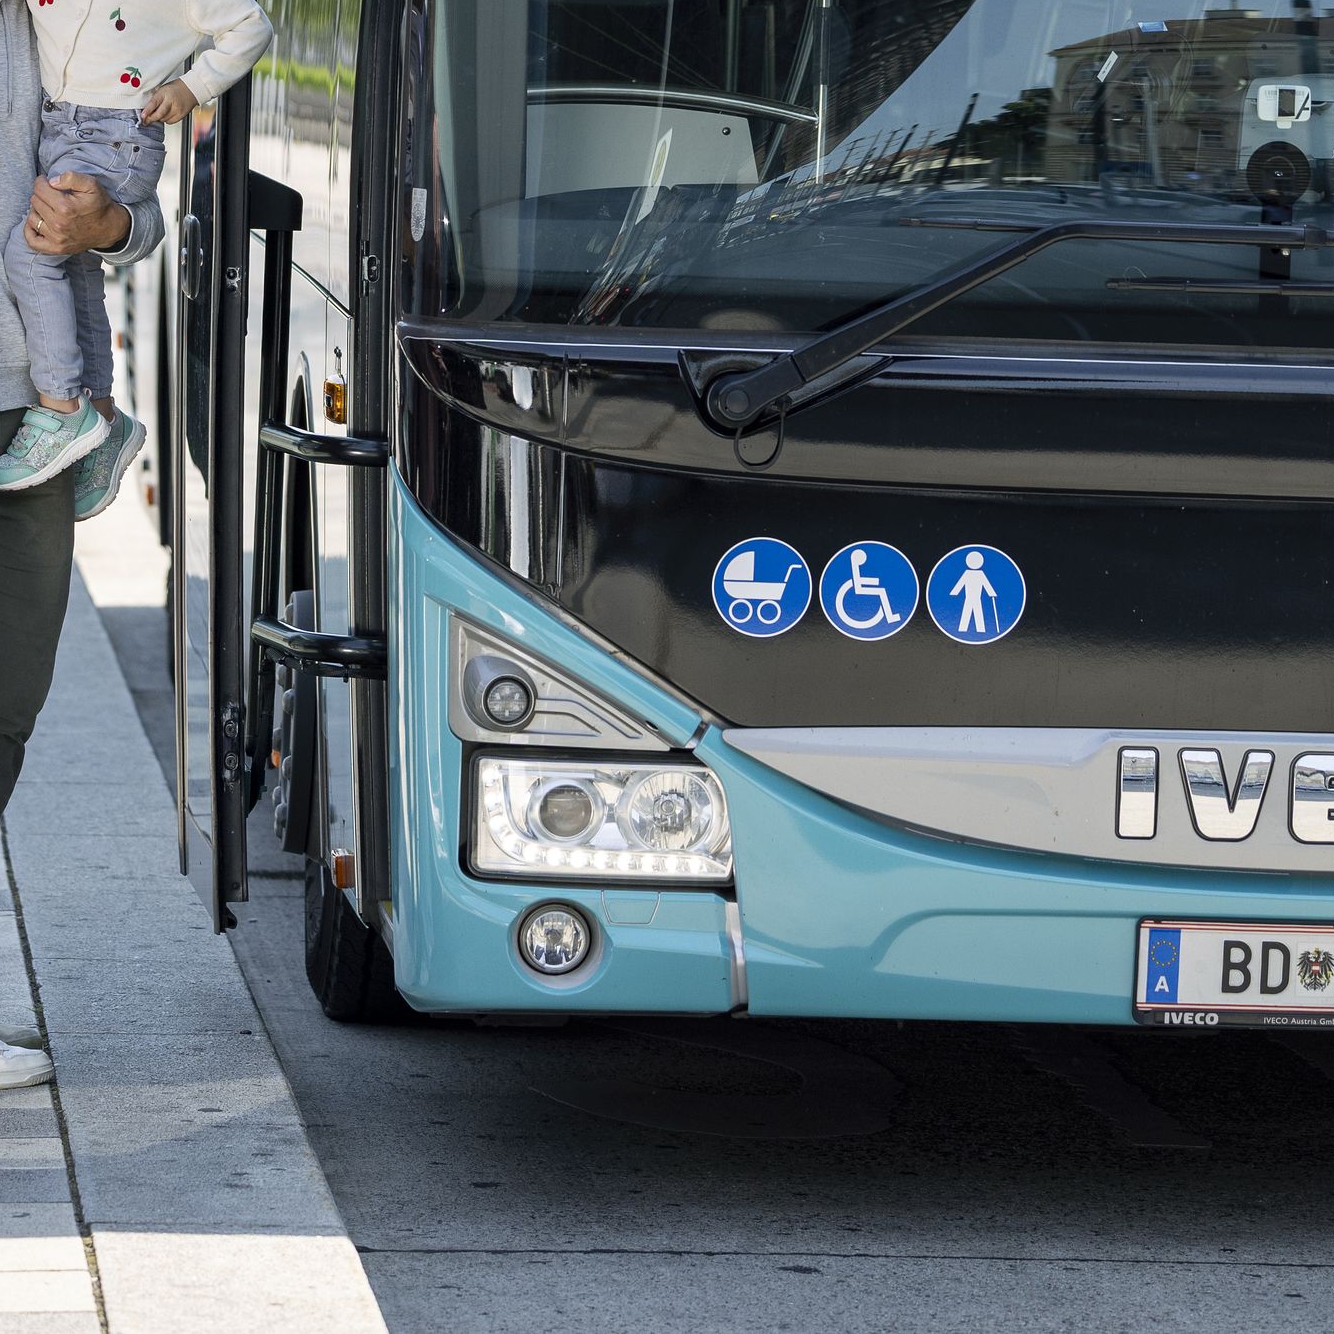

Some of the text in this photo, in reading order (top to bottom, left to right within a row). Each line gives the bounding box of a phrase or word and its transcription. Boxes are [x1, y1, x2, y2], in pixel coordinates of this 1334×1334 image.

[1221, 939, 1291, 995] BD
[1154, 975, 1170, 993] A
[1163, 1011, 1219, 1025] IVECO
[1263, 1016, 1289, 1025] IVECO
[1291, 1017, 1317, 1026] Austria
